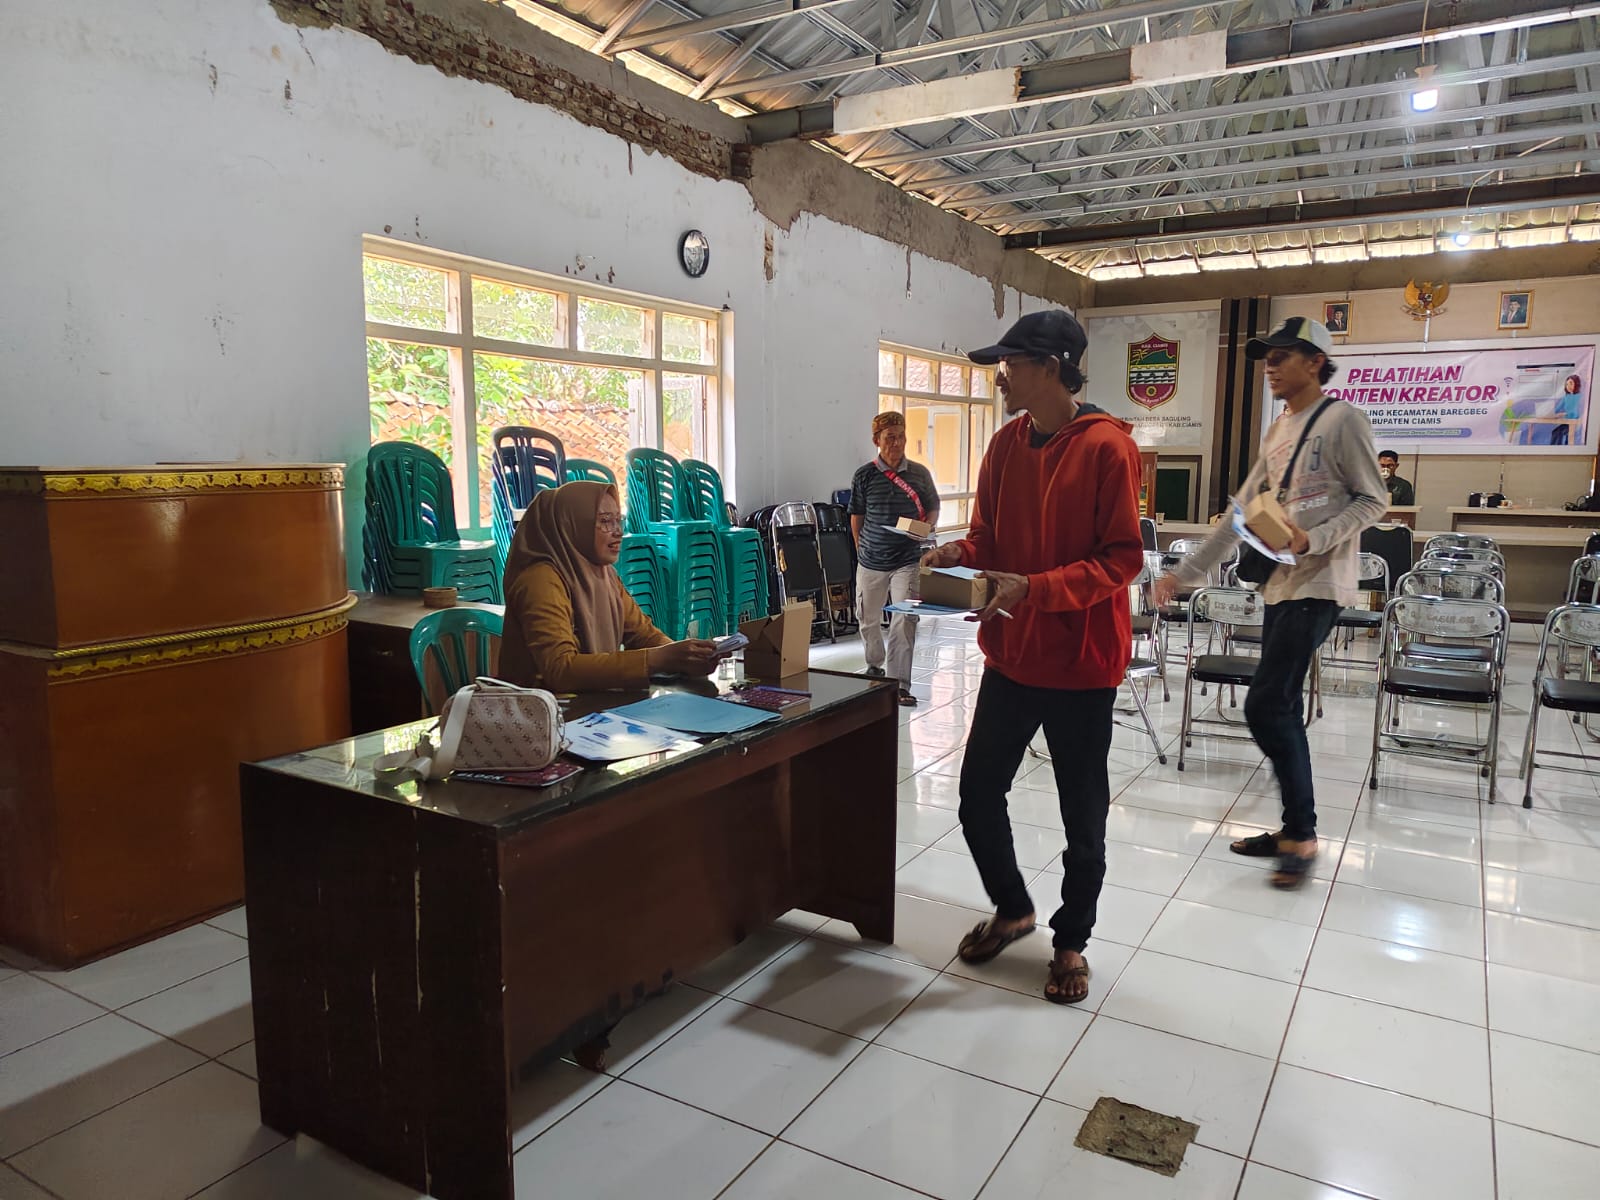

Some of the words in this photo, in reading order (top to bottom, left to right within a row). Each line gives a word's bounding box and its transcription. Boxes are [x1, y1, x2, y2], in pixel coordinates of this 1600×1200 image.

[1347, 365, 1463, 385] PELATIHAN
[1398, 385, 1499, 404] KREATOR
[1386, 408, 1438, 417] KECAMATAN
[1440, 407, 1488, 416] BAREGBEG
[1411, 417, 1442, 425] CIAMIS
